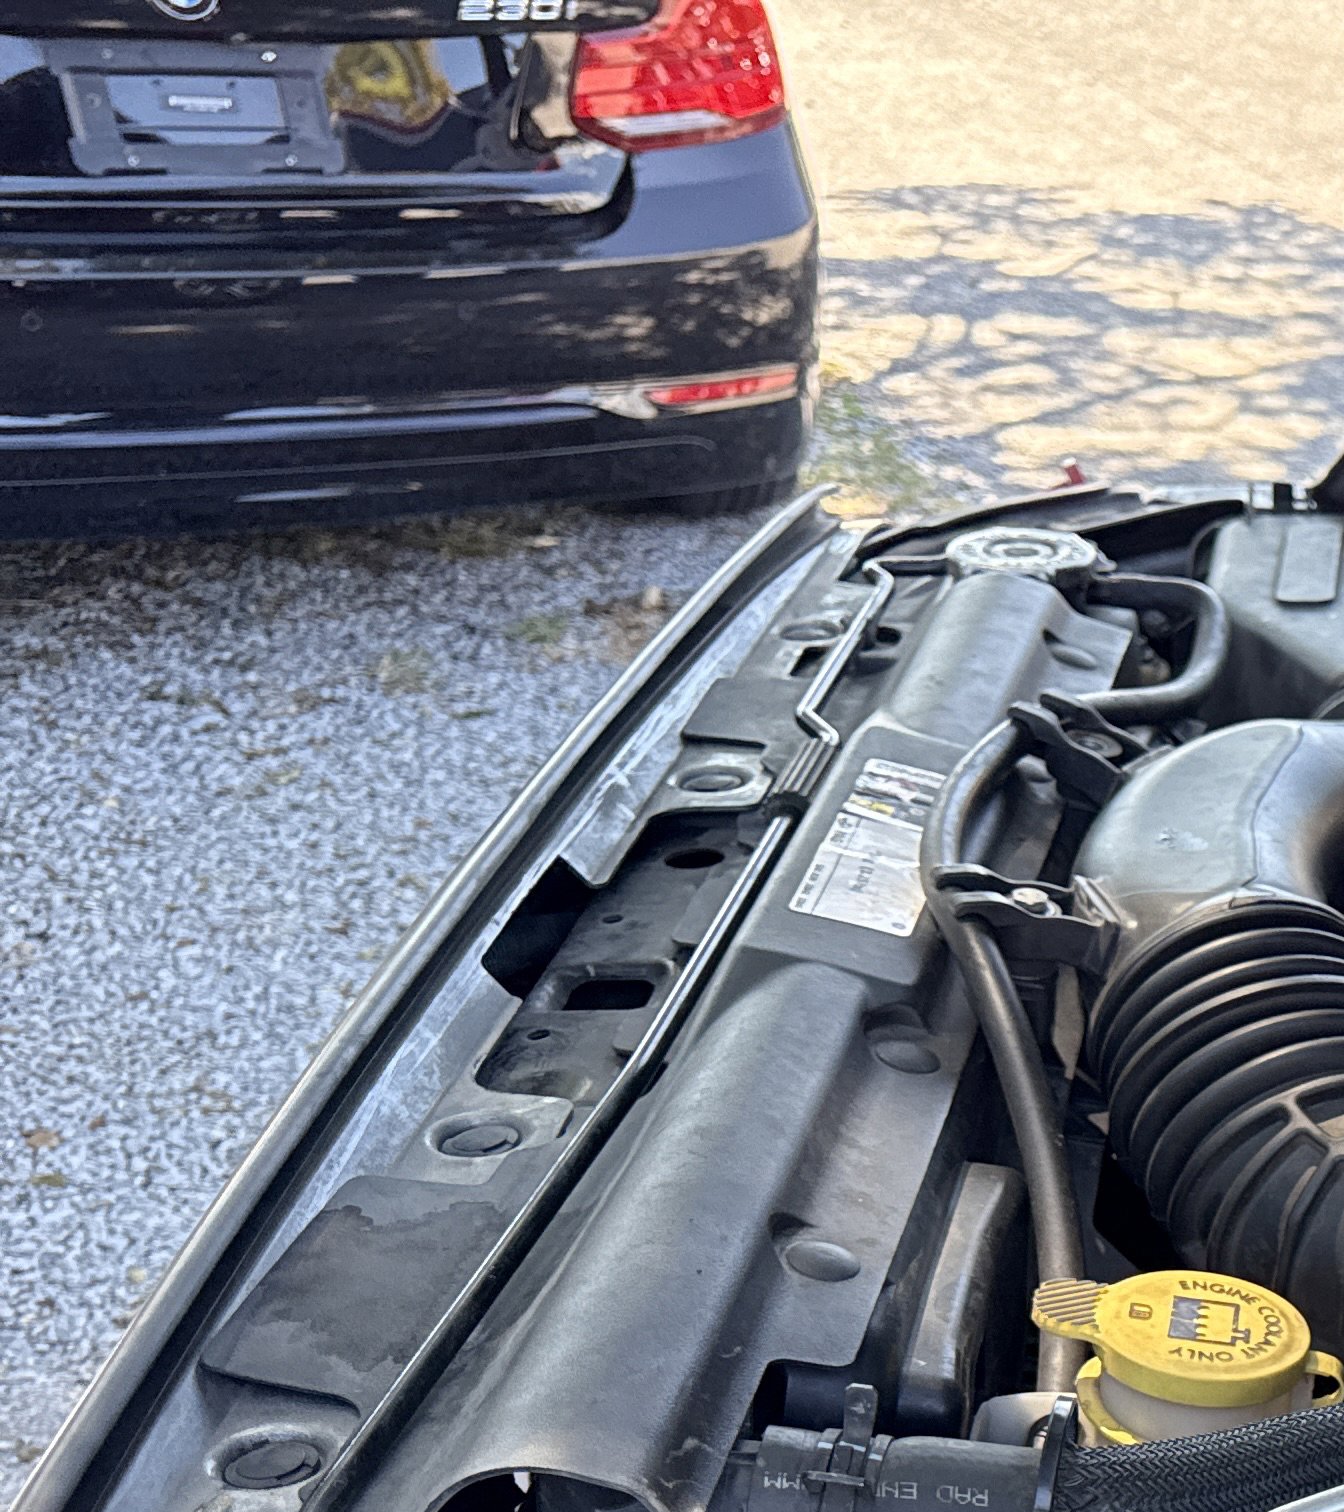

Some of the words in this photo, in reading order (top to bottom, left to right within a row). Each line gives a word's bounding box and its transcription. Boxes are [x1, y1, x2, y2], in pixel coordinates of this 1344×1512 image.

[1178, 1280, 1261, 1306] ENGINE
[1238, 1304, 1286, 1360] COOLANT
[1168, 1345, 1235, 1363] ONLY
[936, 1485, 989, 1508] RAD
